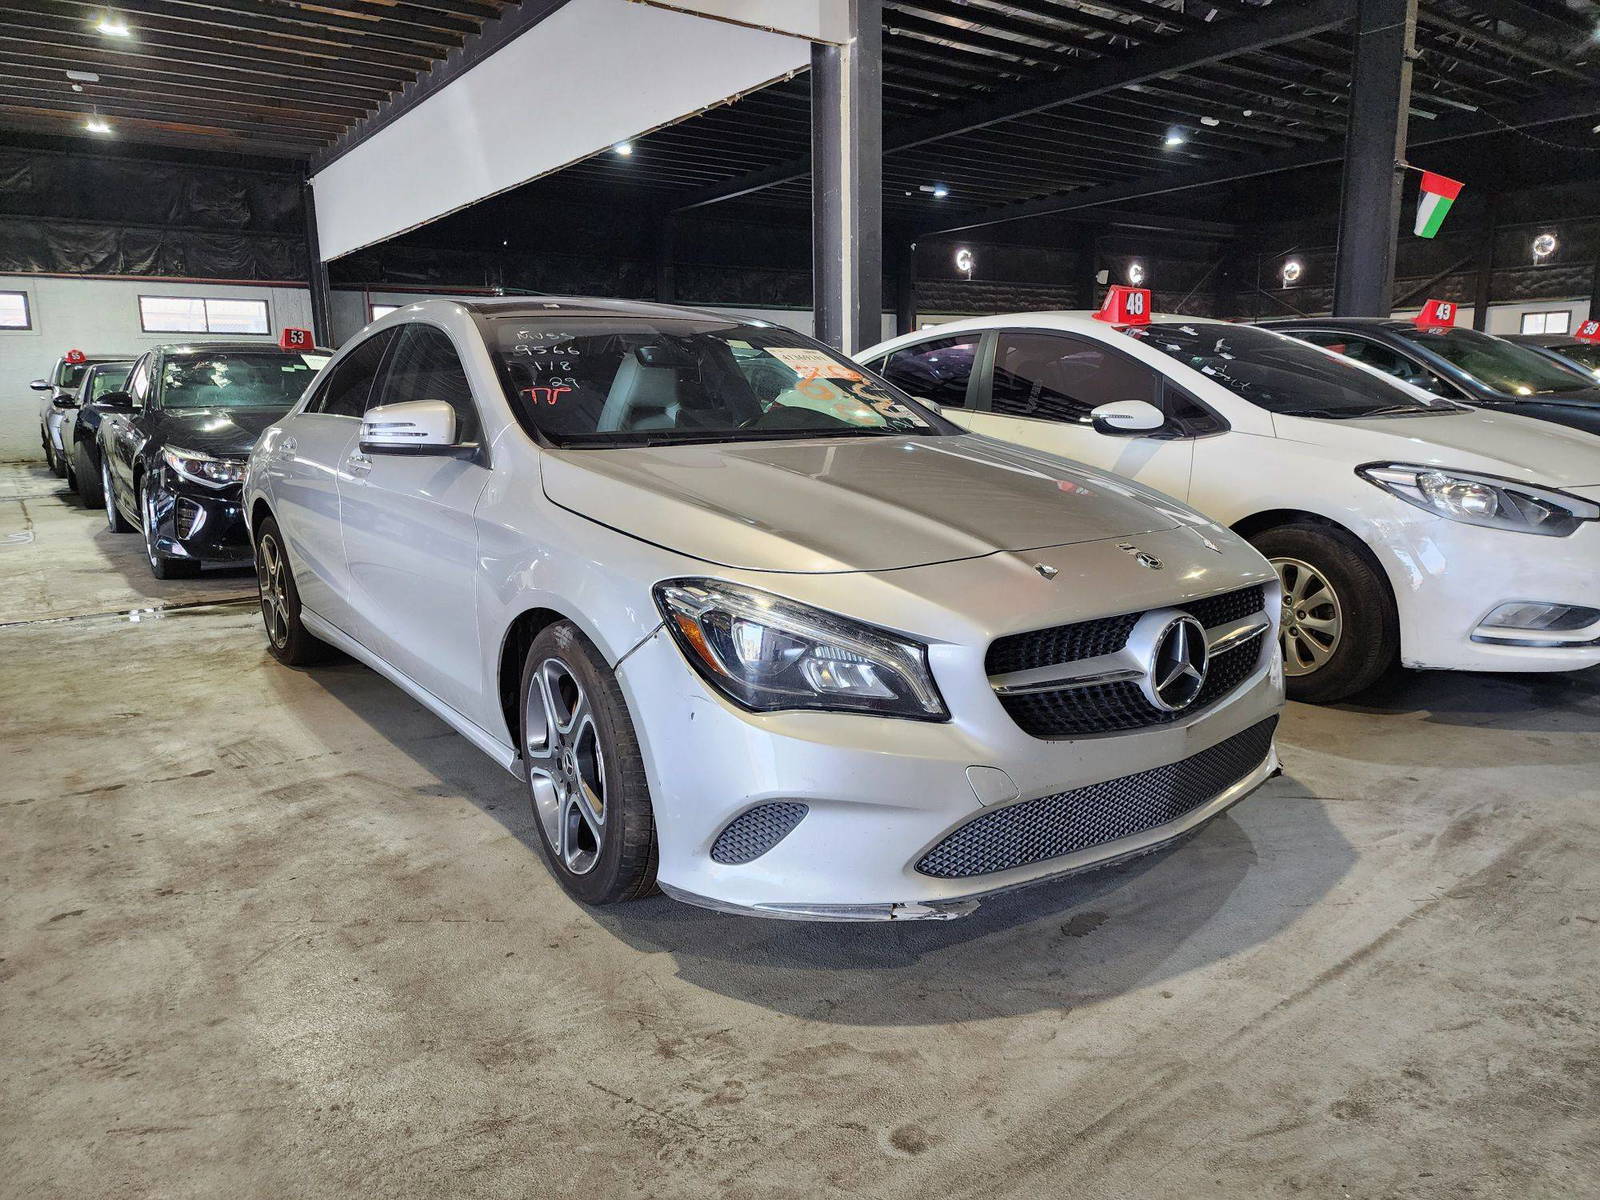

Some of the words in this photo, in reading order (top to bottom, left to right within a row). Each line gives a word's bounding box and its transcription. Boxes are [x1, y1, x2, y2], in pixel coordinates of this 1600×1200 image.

[1127, 293, 1143, 315] 48
[1436, 304, 1451, 320] 43
[291, 330, 304, 344] 53
